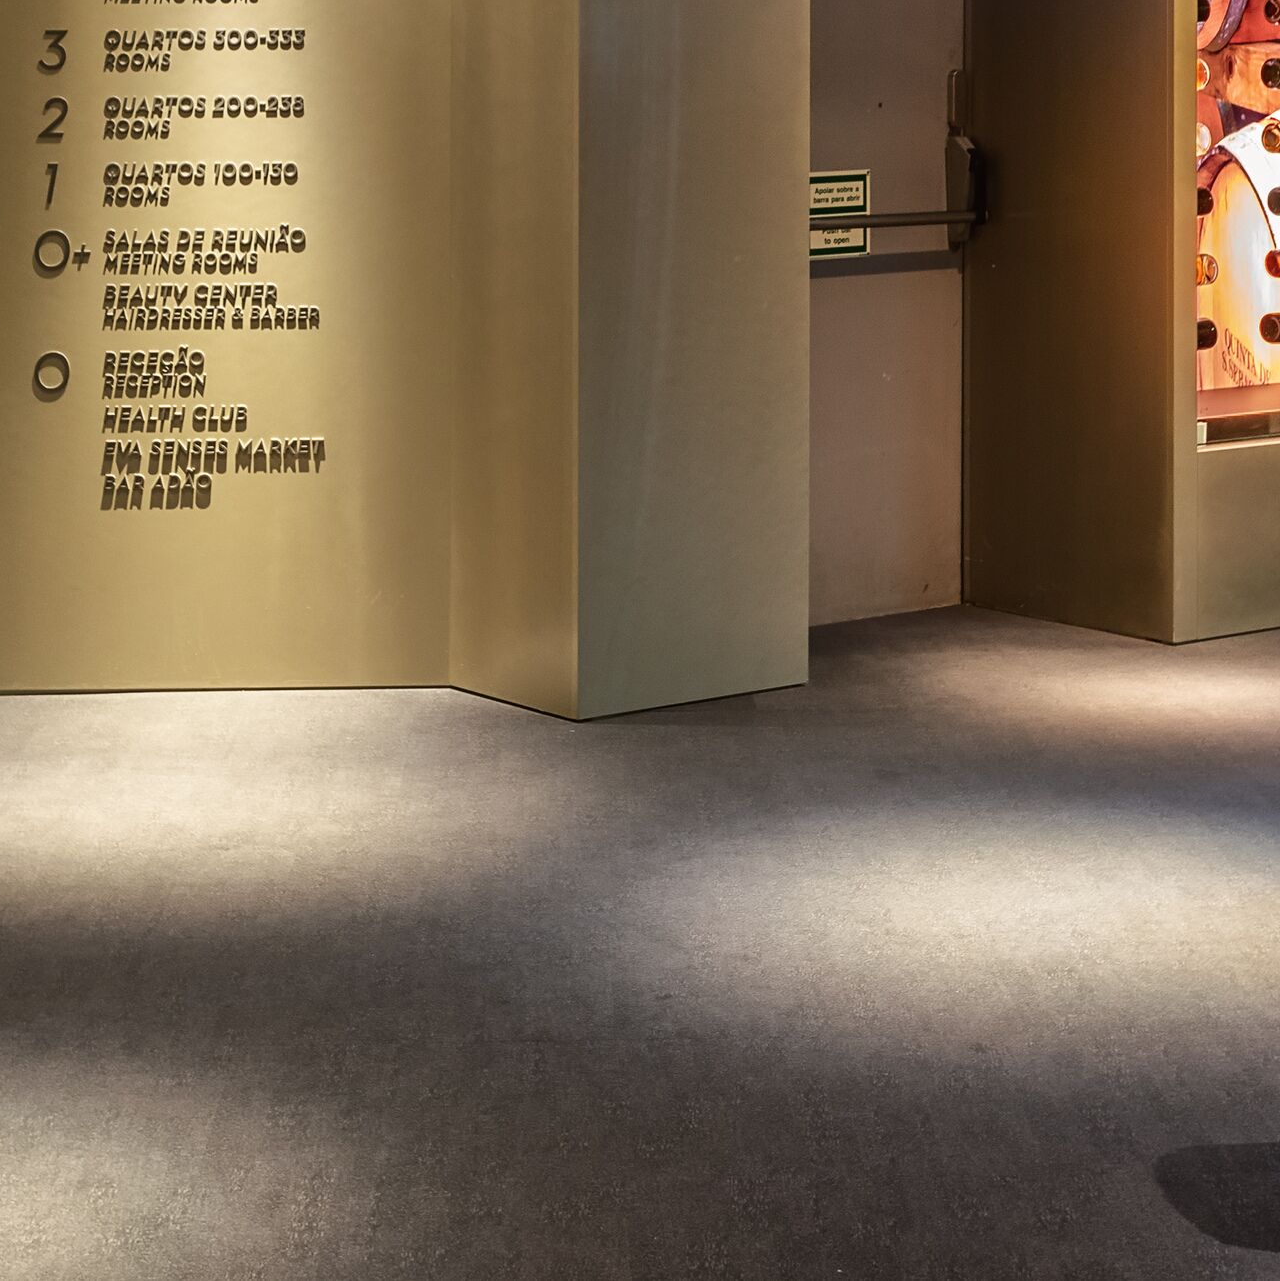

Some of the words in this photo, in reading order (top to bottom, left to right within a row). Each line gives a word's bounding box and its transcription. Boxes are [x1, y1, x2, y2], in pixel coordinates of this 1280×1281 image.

[36, 29, 68, 74] 3
[103, 29, 206, 51] QUARTOS
[212, 29, 306, 50] 300-333
[103, 53, 171, 72] ROOMS
[103, 96, 206, 118] QUARTOS
[212, 95, 306, 117] 200-238
[36, 95, 69, 142] 2
[103, 120, 170, 139] ROOMS
[44, 162, 59, 208] 1
[103, 162, 206, 185] QUARTOS
[213, 162, 299, 185] 100-130
[103, 186, 170, 206] ROOMS
[815, 187, 834, 195] Apoiar
[831, 196, 845, 204] para
[103, 228, 170, 250] SALAS
[176, 228, 205, 250] DE
[211, 223, 307, 251] REUNIÃO
[824, 237, 831, 245] to
[833, 237, 850, 245] open
[103, 252, 186, 273] MEETING
[191, 252, 259, 273] ROOMS
[103, 283, 188, 306] BEAUTY
[194, 282, 278, 306] CENTER
[103, 306, 226, 327] HAIRDRESSER
[231, 306, 244, 327] &
[250, 305, 320, 327] BARBER
[103, 344, 206, 373] RECEÇÃO
[1224, 327, 1257, 377] QUINTA
[103, 373, 207, 394] RECEPTION
[103, 404, 186, 428] HEALTH
[192, 404, 248, 427] CLUB
[102, 438, 142, 467] EVA
[148, 438, 229, 466] SENSES
[235, 437, 326, 465] MARKET
[101, 473, 146, 502] BAR
[150, 467, 212, 501] ADÃO
